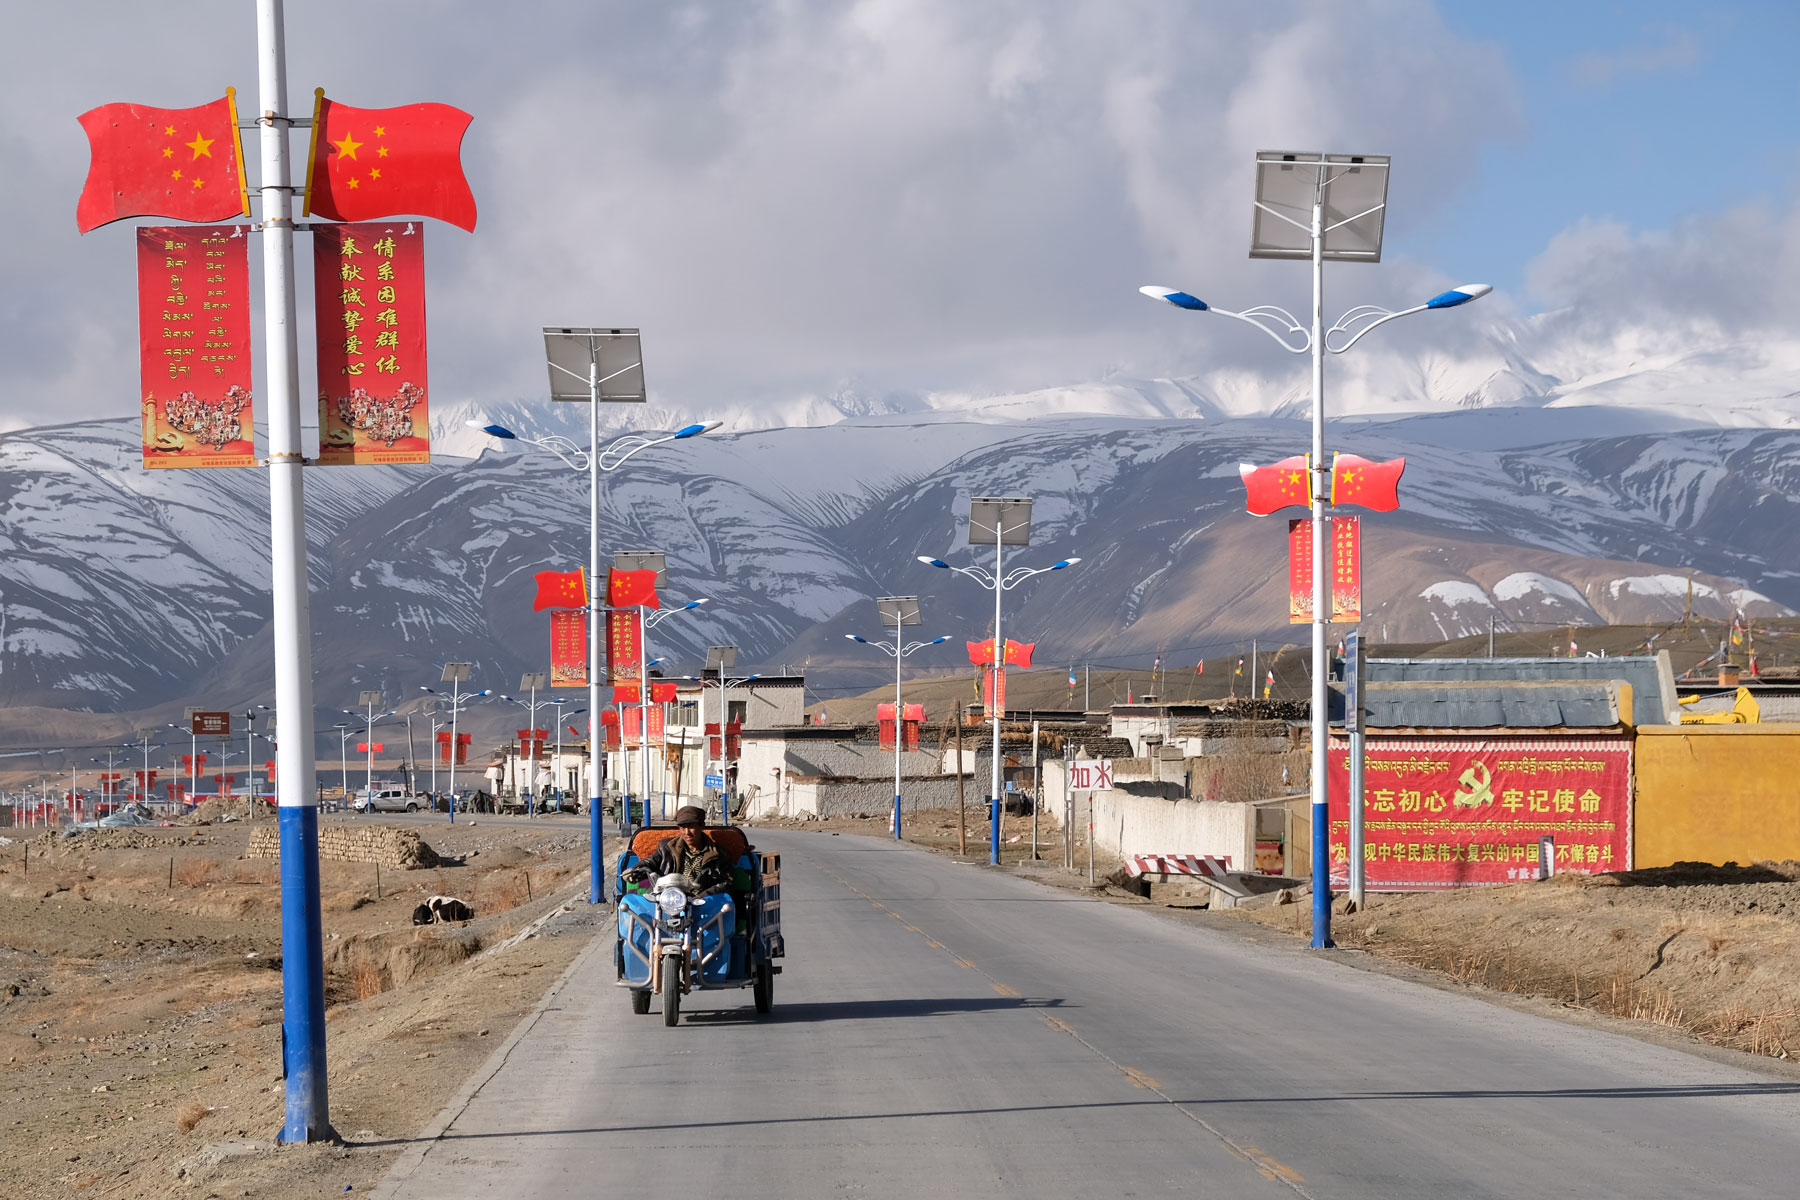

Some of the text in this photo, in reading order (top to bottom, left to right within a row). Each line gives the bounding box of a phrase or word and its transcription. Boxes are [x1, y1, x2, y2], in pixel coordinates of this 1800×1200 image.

[338, 236, 366, 376] 奉献诚挚爱心
[372, 236, 401, 375] 情系困难群体
[1068, 761, 1113, 788] 加水
[1501, 788, 1602, 814] 牢记使命
[1334, 842, 1615, 864] 为现中华民族伟大复兴的中国不懈奋斗
